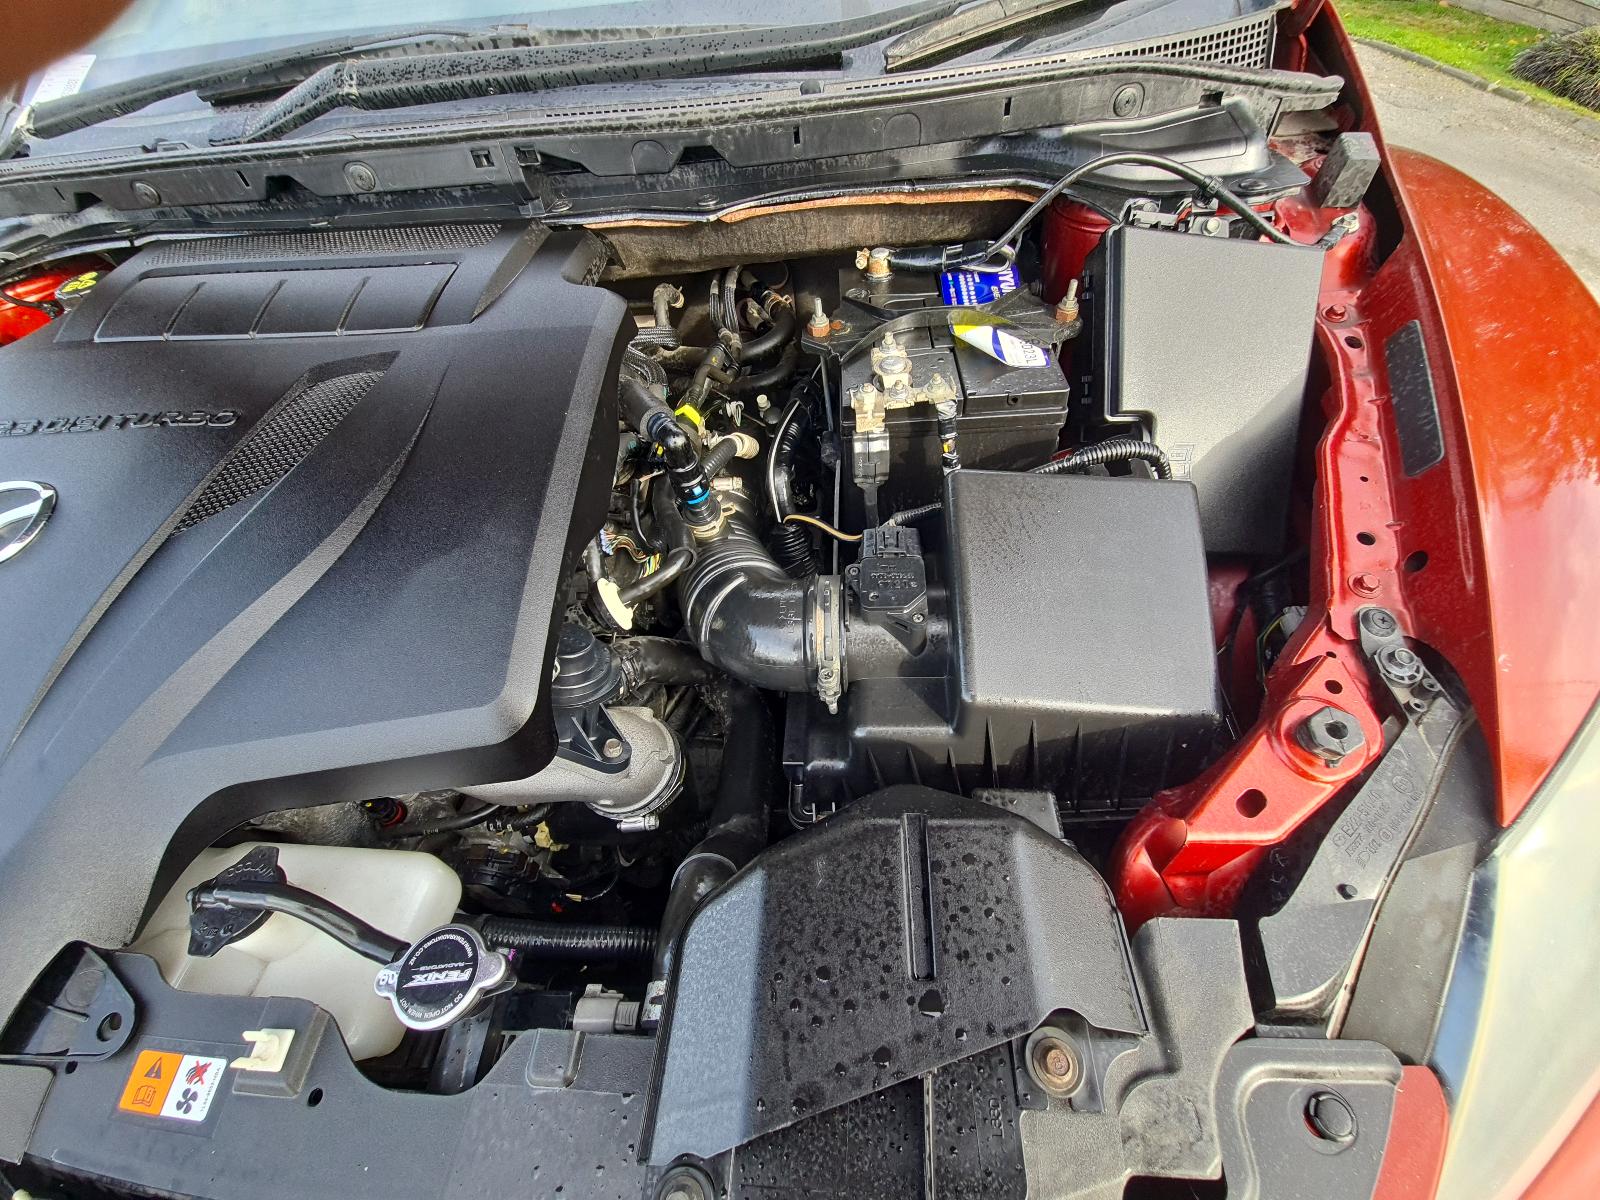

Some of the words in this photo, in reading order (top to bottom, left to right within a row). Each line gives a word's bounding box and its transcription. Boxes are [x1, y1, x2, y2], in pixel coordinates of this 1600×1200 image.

[112, 409, 241, 430] TURBO
[408, 967, 473, 985] FENIX
[399, 997, 410, 1010] HOT
[453, 992, 464, 1003] DO
[407, 1007, 423, 1019] WHEN
[423, 1009, 441, 1019] OPEN
[440, 1002, 454, 1015] NOT
